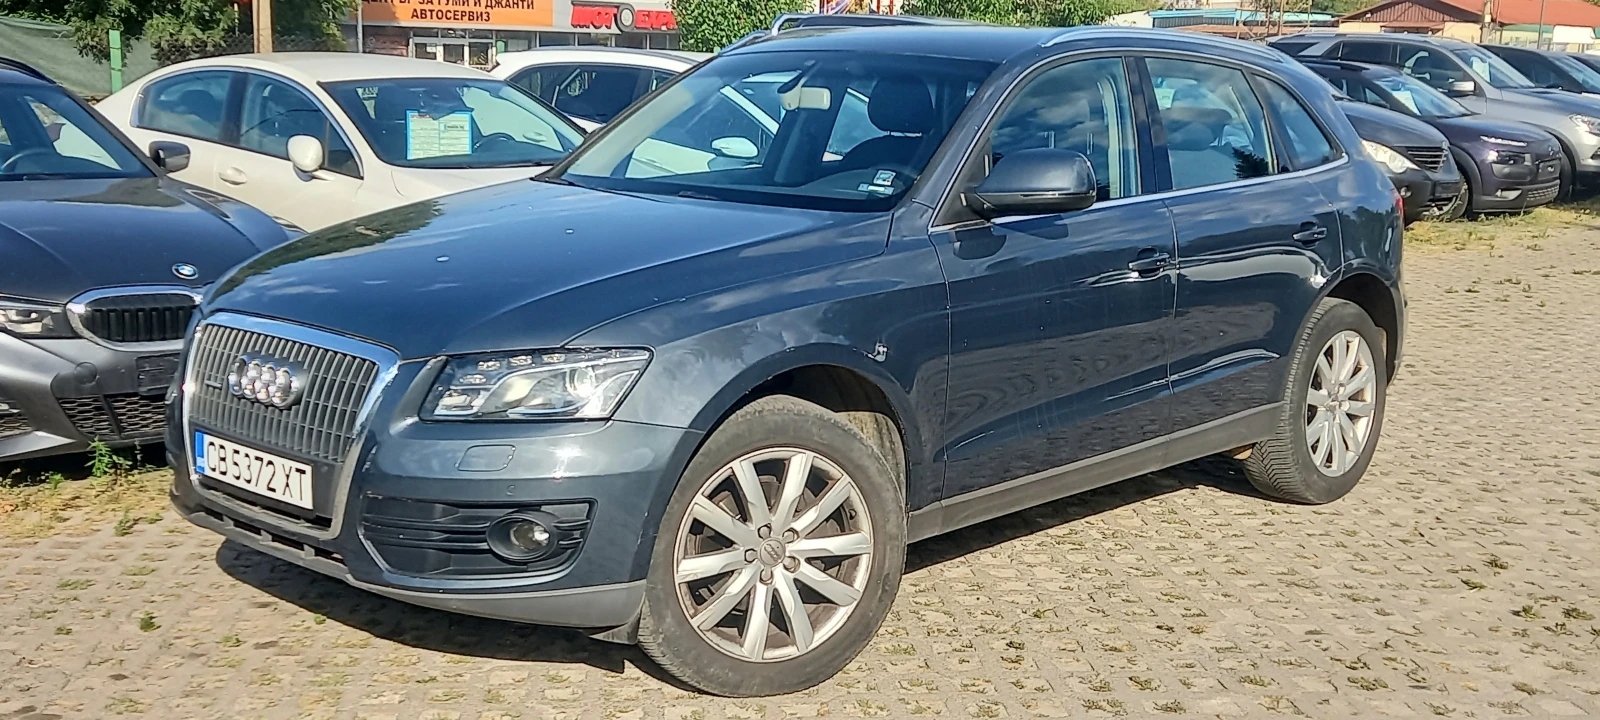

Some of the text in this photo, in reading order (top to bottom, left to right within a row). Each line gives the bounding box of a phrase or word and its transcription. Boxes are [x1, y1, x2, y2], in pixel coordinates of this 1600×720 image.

[485, 0, 534, 10] ДЖАНТИ
[411, 8, 490, 22] АВТОСЕРВИЗ
[207, 441, 306, 501] CB 5372 XT
